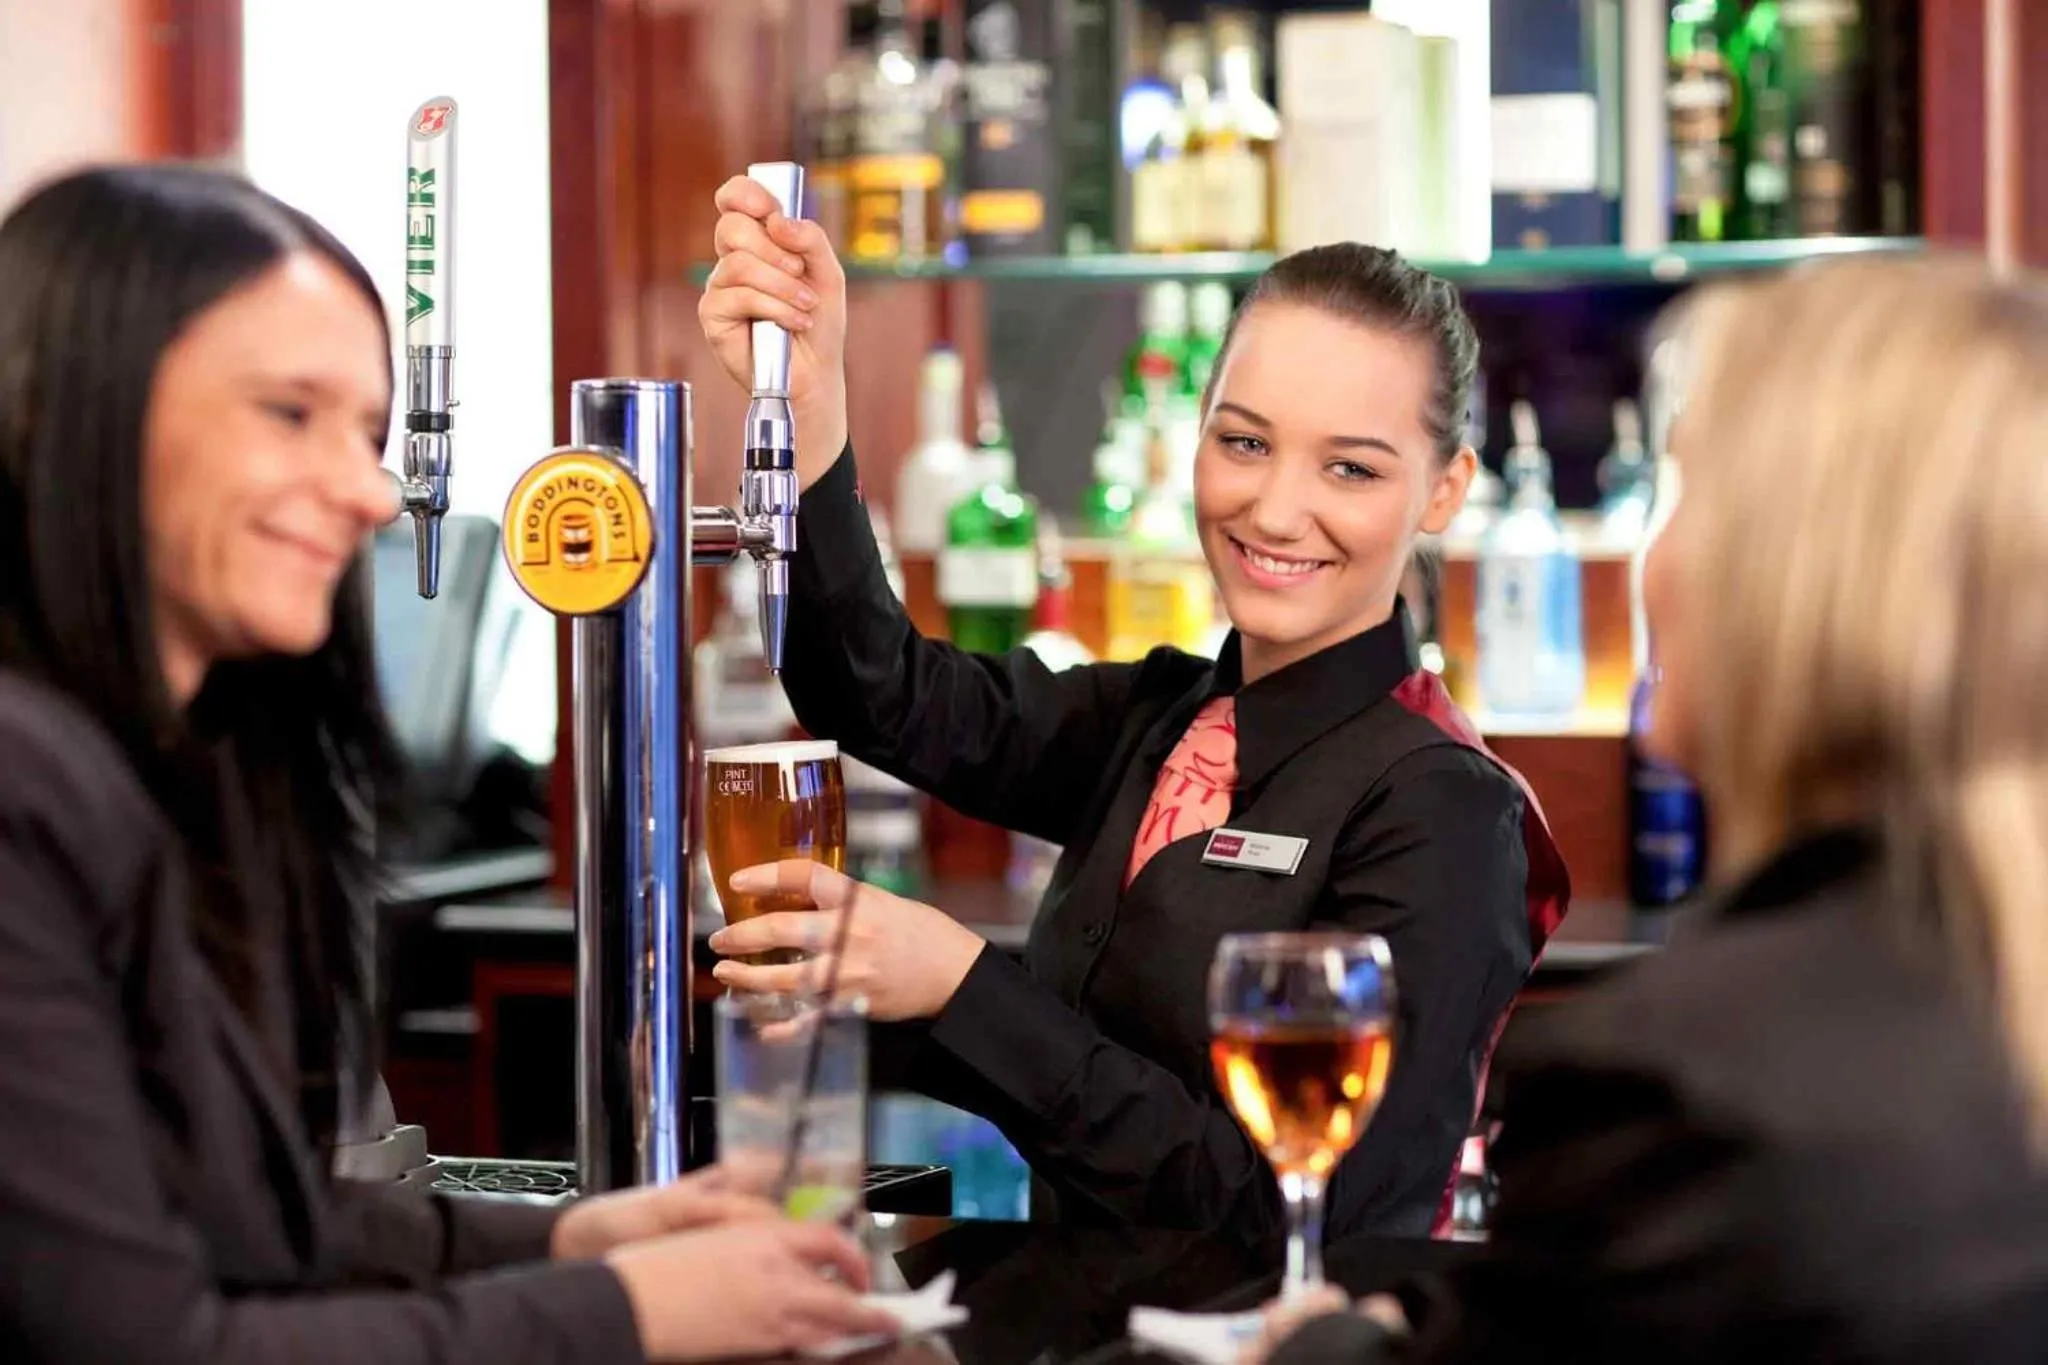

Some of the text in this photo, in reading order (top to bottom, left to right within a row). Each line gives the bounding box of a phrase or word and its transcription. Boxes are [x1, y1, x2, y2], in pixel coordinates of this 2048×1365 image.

[406, 167, 435, 327] VIER
[526, 476, 626, 543] BODDINGTONS
[724, 768, 746, 779] PINT
